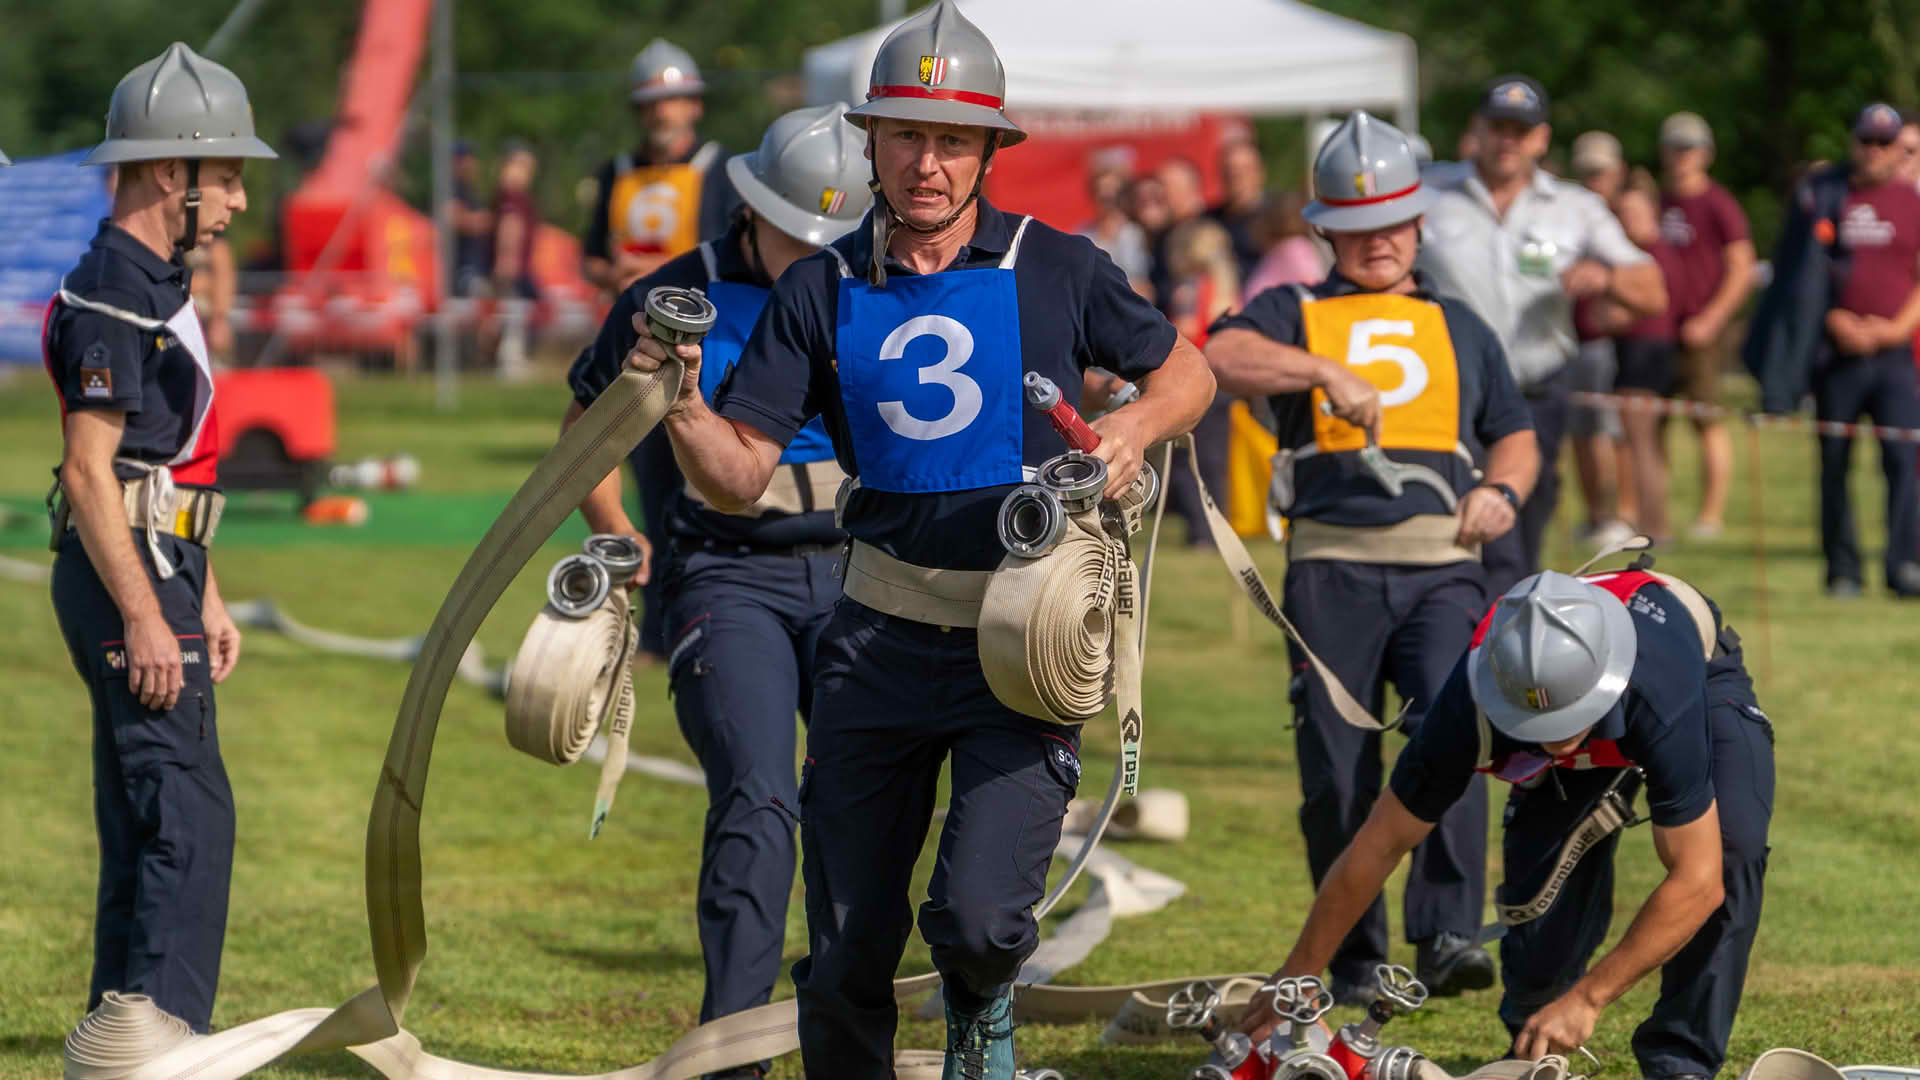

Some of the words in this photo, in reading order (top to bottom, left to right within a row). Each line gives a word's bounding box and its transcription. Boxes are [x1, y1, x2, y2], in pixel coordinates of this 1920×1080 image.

[630, 181, 678, 240] 6
[876, 314, 983, 441] 3
[1347, 318, 1430, 406] 5
